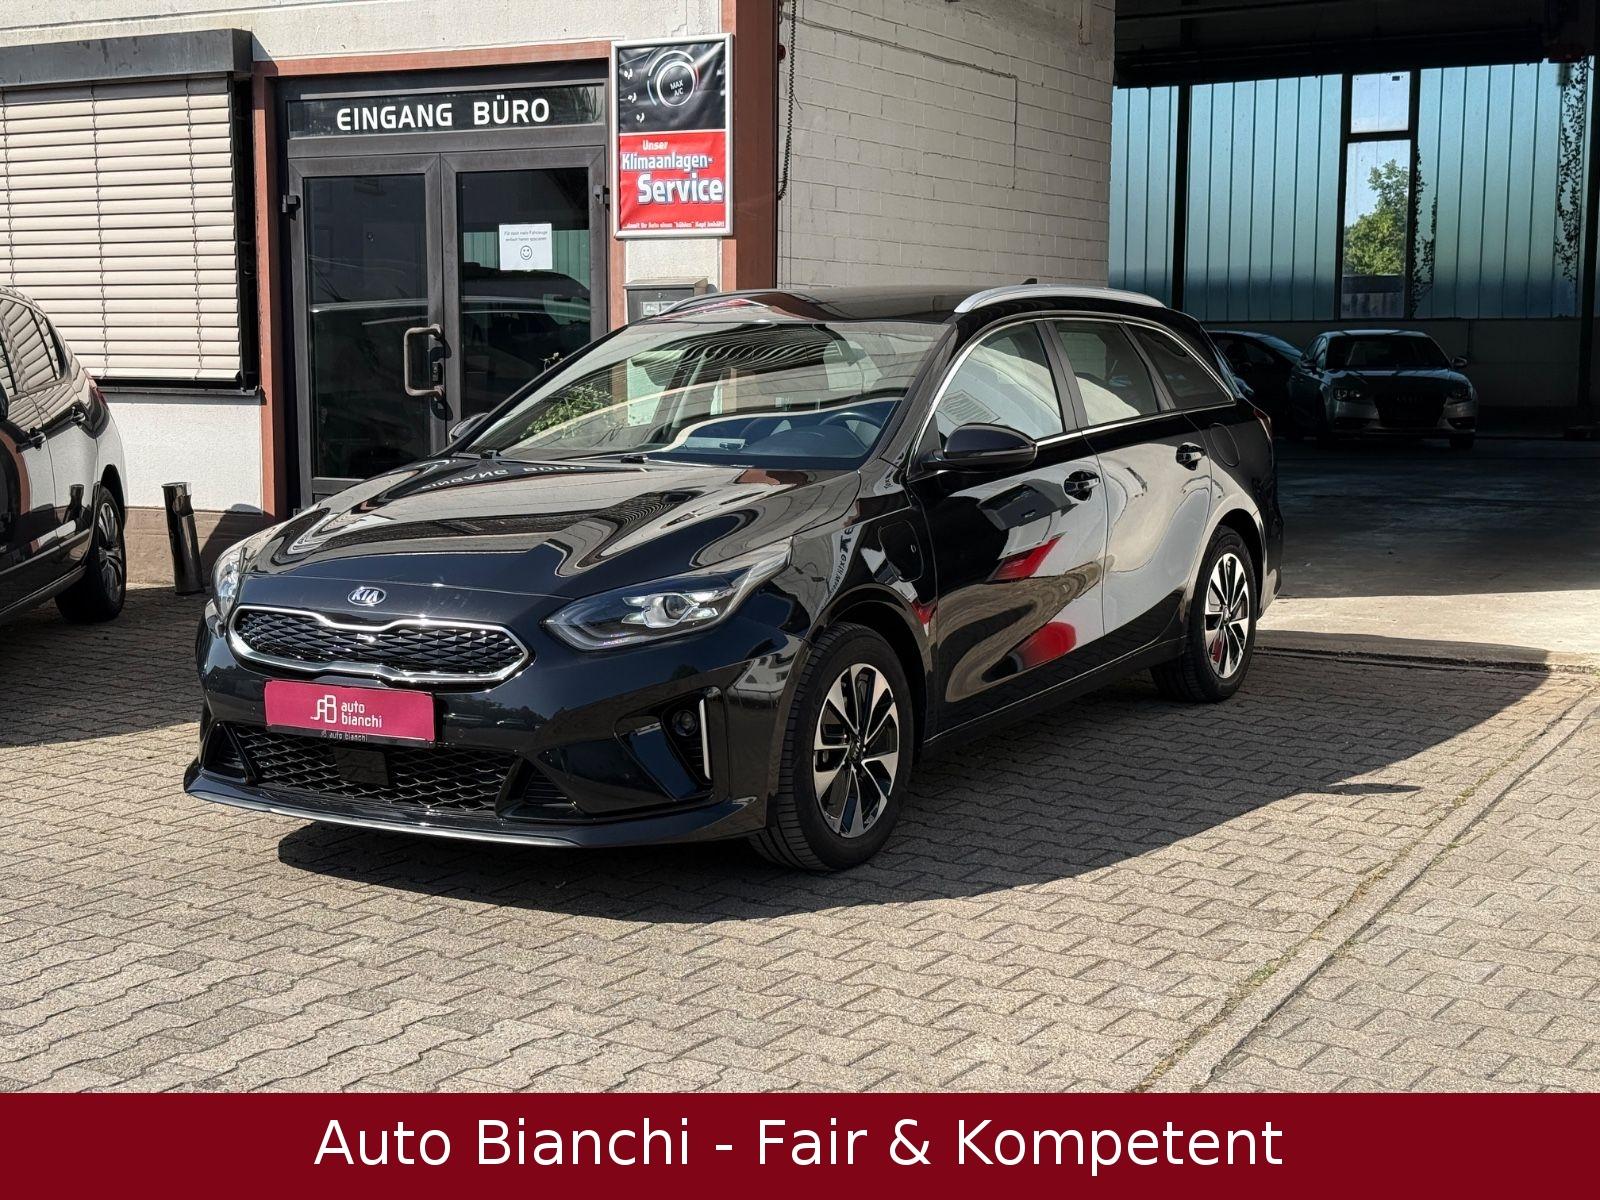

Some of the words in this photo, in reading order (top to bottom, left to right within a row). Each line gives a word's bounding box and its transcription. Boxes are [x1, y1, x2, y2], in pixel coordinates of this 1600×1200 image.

[670, 79, 684, 90] MAX
[336, 103, 453, 131] EINGANG
[473, 94, 550, 126] BÜRO
[642, 139, 669, 151] Unser
[621, 151, 713, 172] Klimaanlagen-
[637, 172, 723, 203] Service
[351, 589, 379, 602] KIA
[341, 700, 365, 714] auto
[341, 713, 383, 728] bianchi
